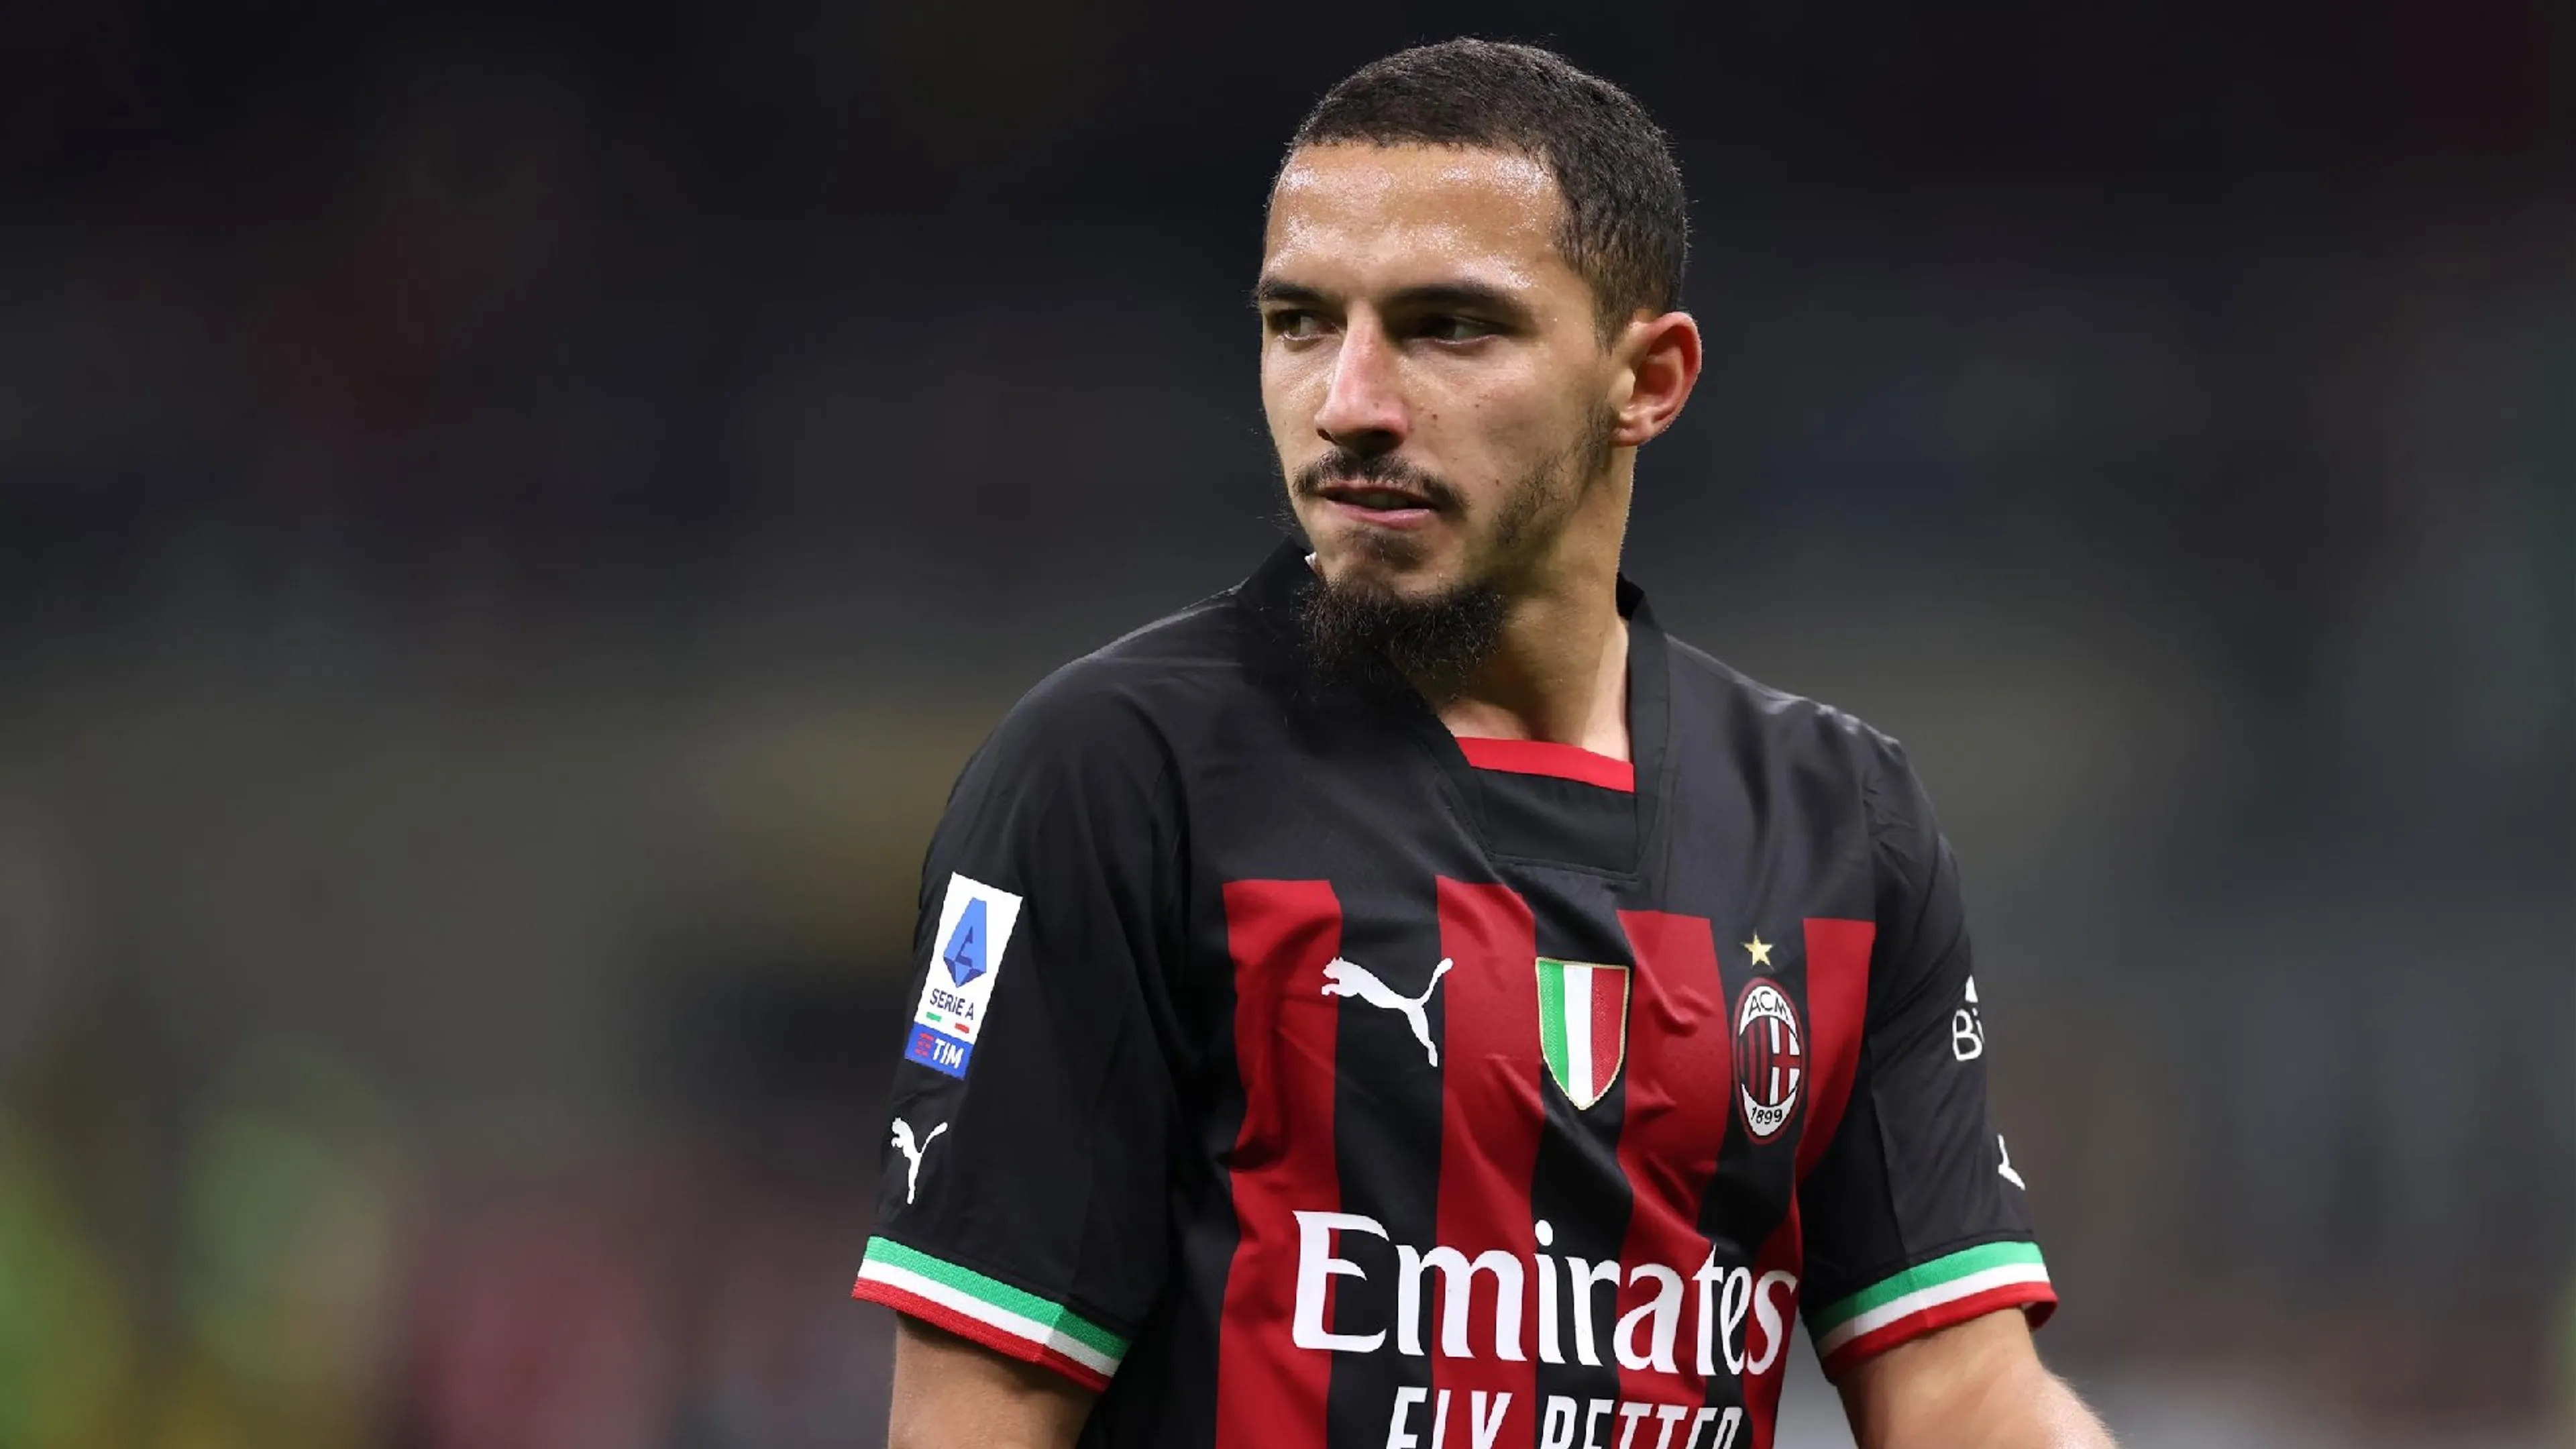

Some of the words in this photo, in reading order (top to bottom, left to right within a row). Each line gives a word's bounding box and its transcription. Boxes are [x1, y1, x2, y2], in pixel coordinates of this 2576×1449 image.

[930, 988, 965, 1016] SERIE
[965, 1002, 974, 1020] A
[1748, 990, 1789, 1020] ACM
[932, 1038, 964, 1069] TIM
[1751, 1106, 1782, 1124] 1899
[1292, 1210, 1798, 1375] Emirates
